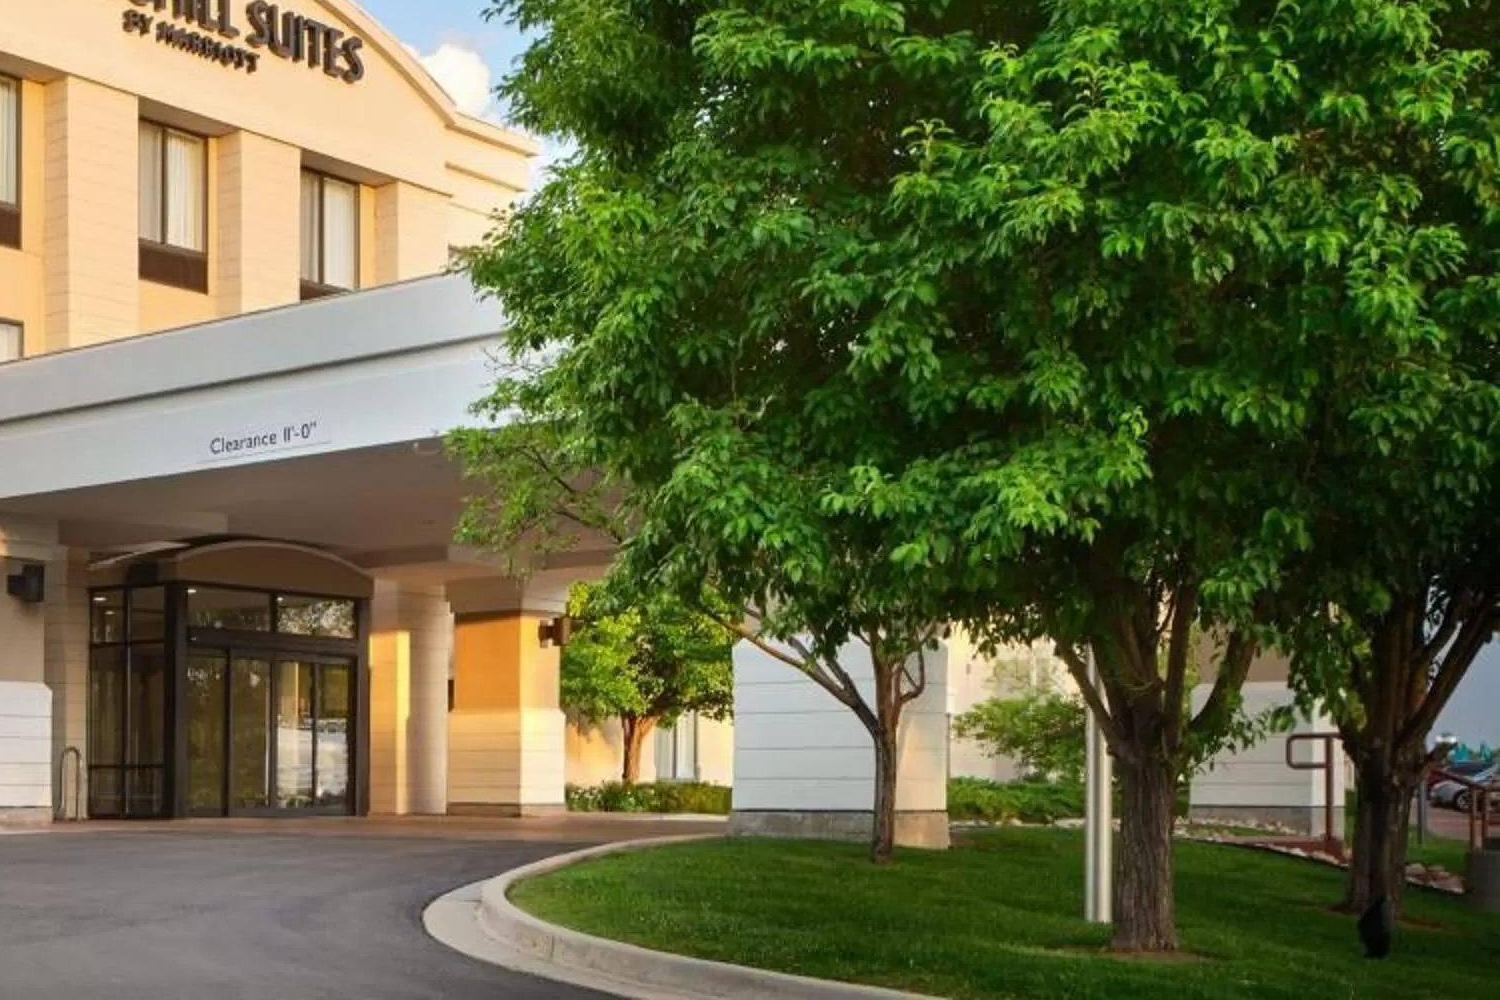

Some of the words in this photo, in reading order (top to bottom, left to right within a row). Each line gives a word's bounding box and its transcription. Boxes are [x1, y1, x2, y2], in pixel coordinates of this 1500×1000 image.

[122, 9, 154, 36] BY
[156, 21, 260, 73] MARRIOTT
[245, 0, 365, 83] SUITES
[210, 433, 277, 454] Clearance
